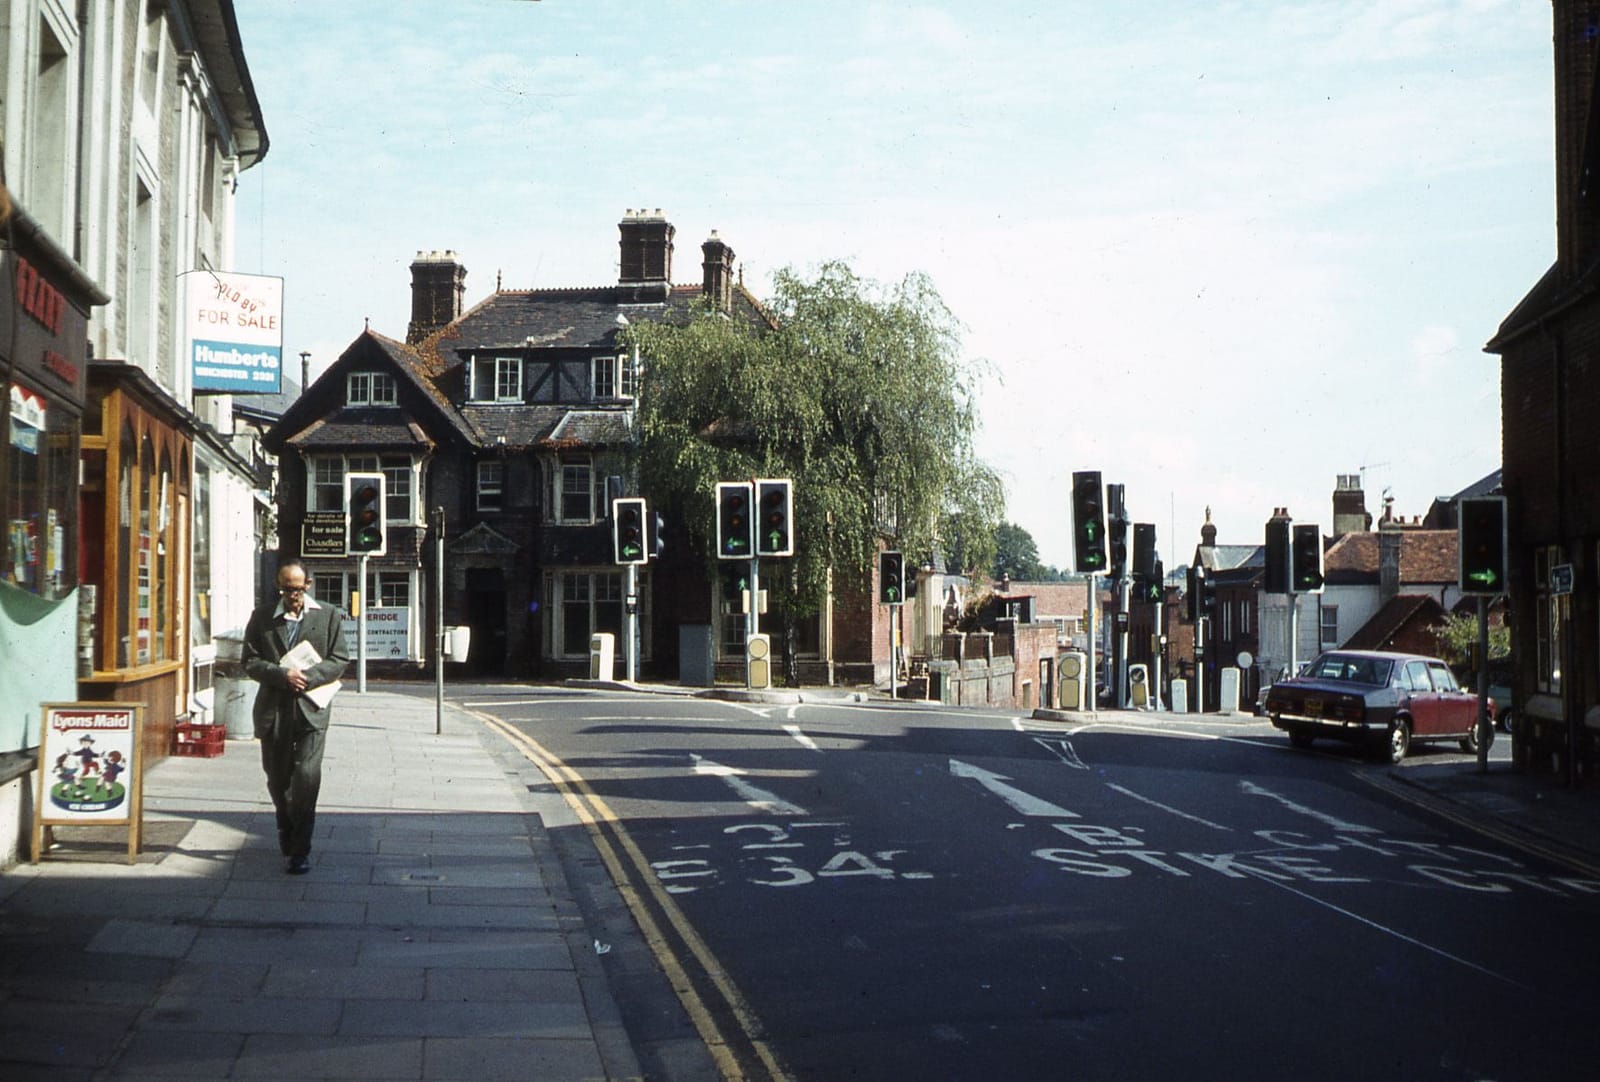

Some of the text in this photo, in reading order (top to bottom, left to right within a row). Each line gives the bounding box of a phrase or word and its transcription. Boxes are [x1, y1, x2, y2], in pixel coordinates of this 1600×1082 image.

[198, 309, 277, 330] FOR SALE
[195, 346, 278, 368] Humberts
[311, 525, 344, 533] for sale
[54, 713, 128, 729] Lyons Maid
[1030, 847, 1371, 883] STKE
